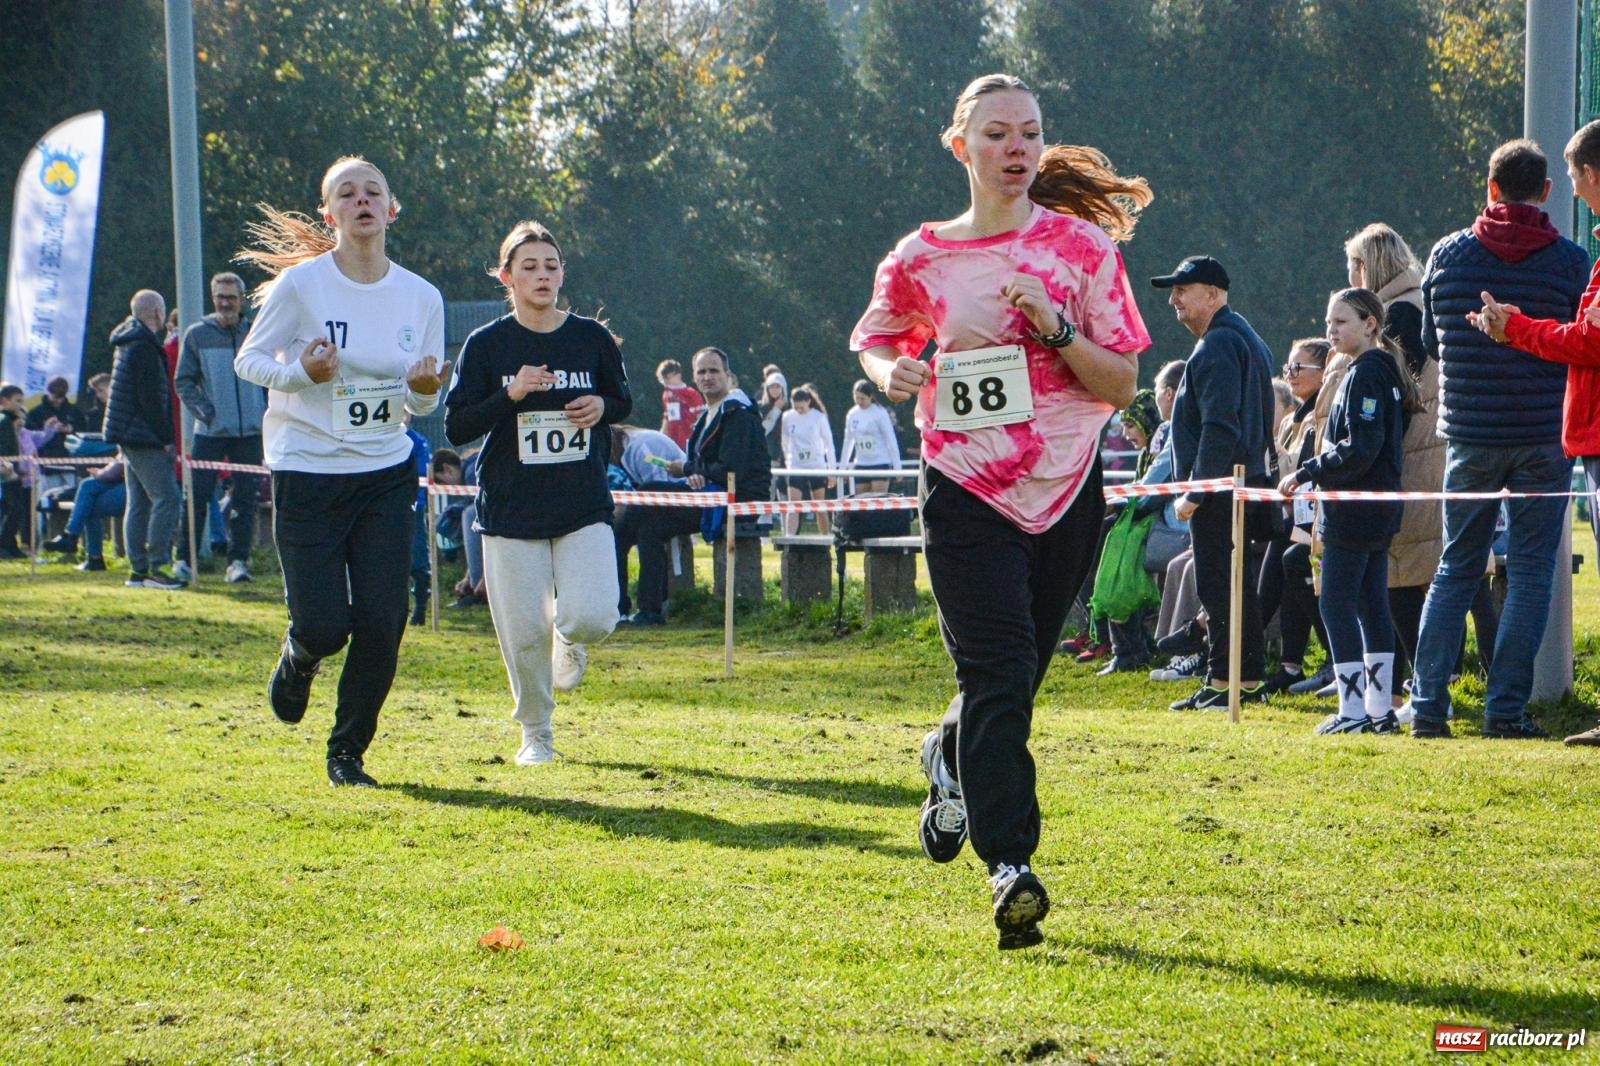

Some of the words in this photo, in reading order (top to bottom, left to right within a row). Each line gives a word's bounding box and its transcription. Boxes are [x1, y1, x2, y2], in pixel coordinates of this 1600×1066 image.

[326, 320, 347, 348] 17
[957, 353, 1019, 367] www.personalbest.pl
[952, 376, 1008, 416] 88
[348, 399, 391, 427] 94
[524, 428, 587, 454] 104
